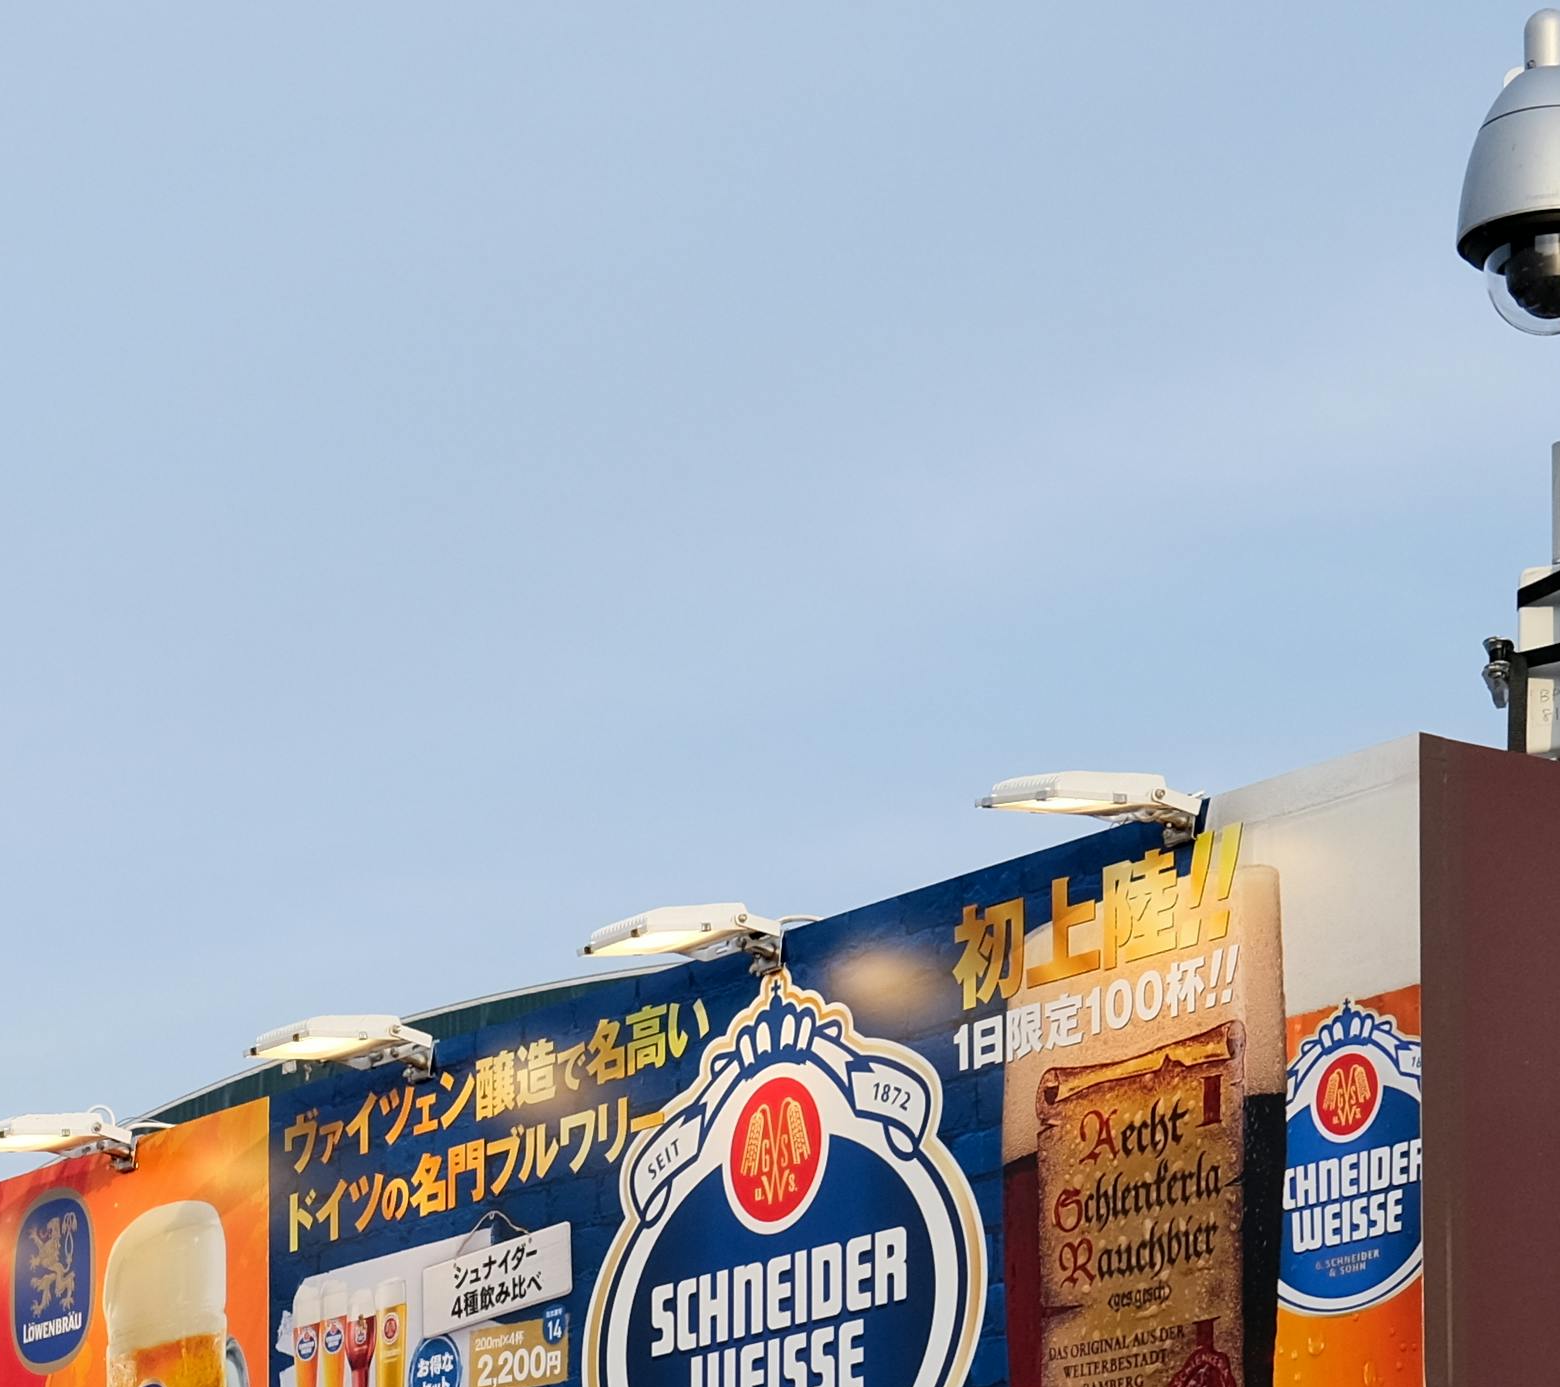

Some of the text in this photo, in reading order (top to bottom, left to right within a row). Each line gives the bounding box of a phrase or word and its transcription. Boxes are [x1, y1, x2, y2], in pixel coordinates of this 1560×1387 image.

[952, 822, 1244, 1010] 初上陸!!
[954, 945, 1239, 1071] 1日限定100杯!!
[285, 998, 709, 1174] ヴァイツェン醸造で名高い
[873, 1081, 911, 1110] 1872
[1080, 1098, 1193, 1166] Aecht
[289, 1097, 665, 1252] ドイツの名門ブルワリー
[648, 1139, 680, 1180] SEIT
[1292, 1189, 1403, 1254] WEISSE
[453, 1241, 538, 1290] シュナイダー
[1059, 1217, 1220, 1288] Rauchbier
[450, 1271, 543, 1320] 4種飲み比べ
[651, 1226, 907, 1357] SCHNEIDER
[22, 1310, 83, 1345] LÖWENBRÄU
[547, 1318, 562, 1340] 14
[1049, 1323, 1185, 1361] DAS ORIGINAL AUS DER
[416, 1352, 454, 1378] お得な
[1063, 1348, 1168, 1379] WELTERBESTADT
